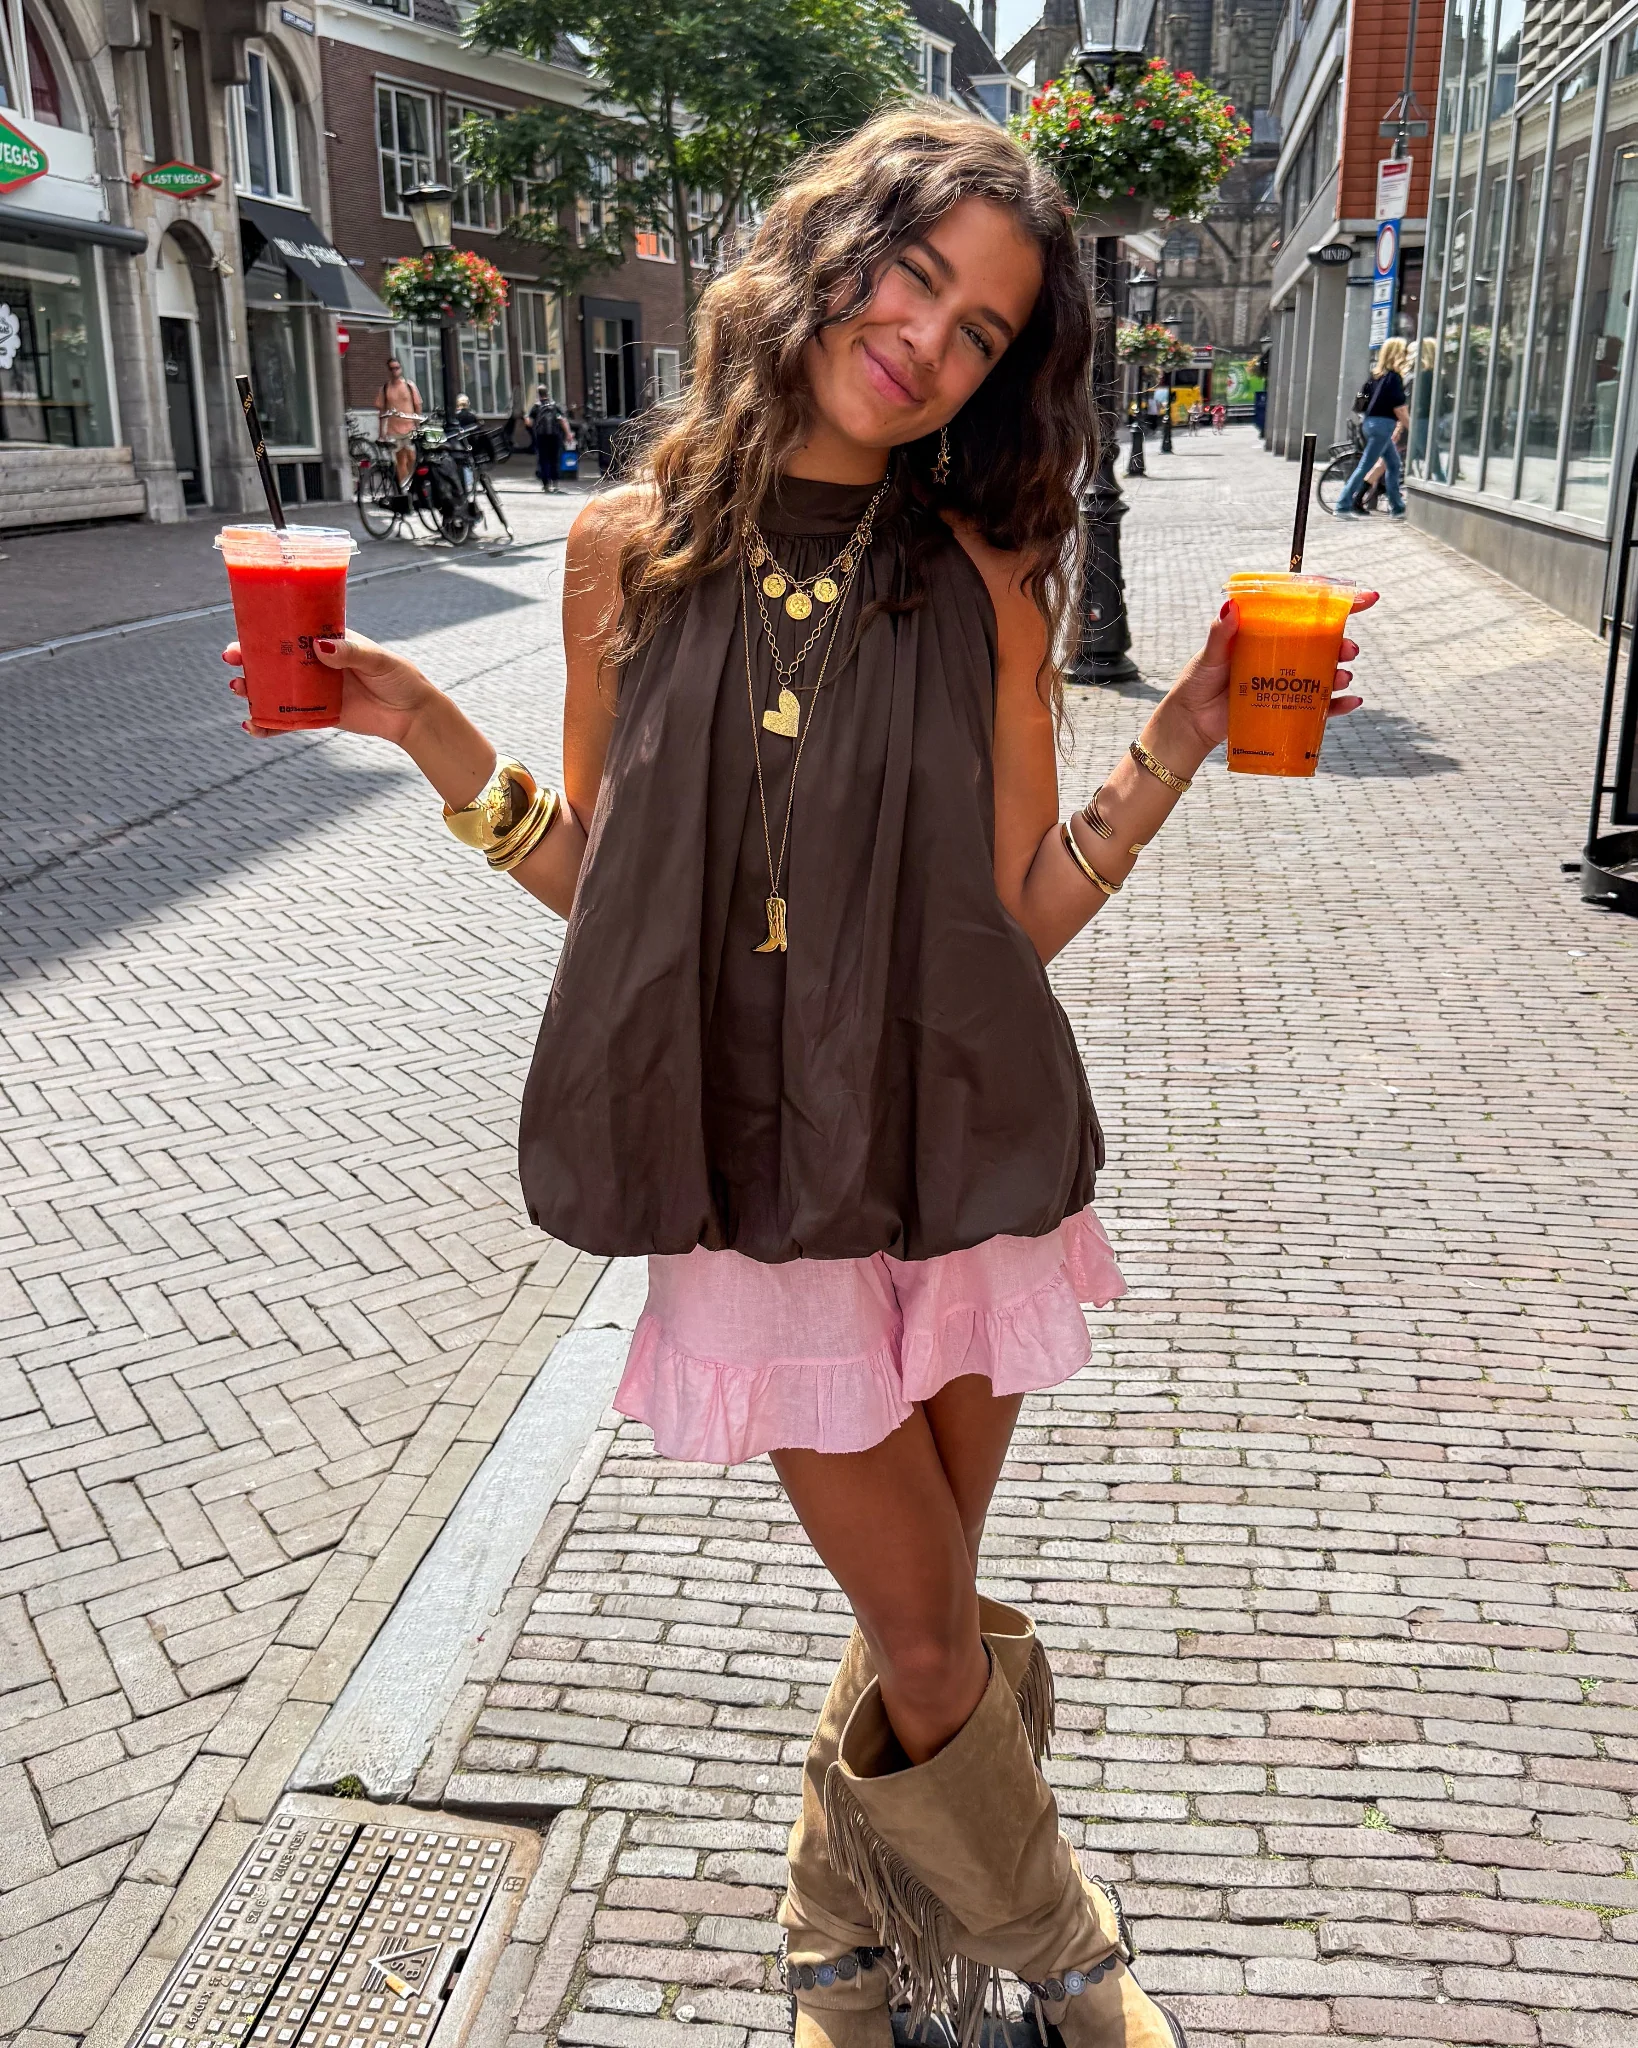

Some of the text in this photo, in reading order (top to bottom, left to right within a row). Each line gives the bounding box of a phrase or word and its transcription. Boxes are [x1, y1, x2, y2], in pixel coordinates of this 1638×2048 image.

[147, 173, 207, 185] LAST VEGAS
[1280, 668, 1296, 677] THE
[1251, 676, 1320, 693] SMOOTH
[1256, 692, 1313, 704] BROTHERS
[245, 1908, 263, 1924] 125
